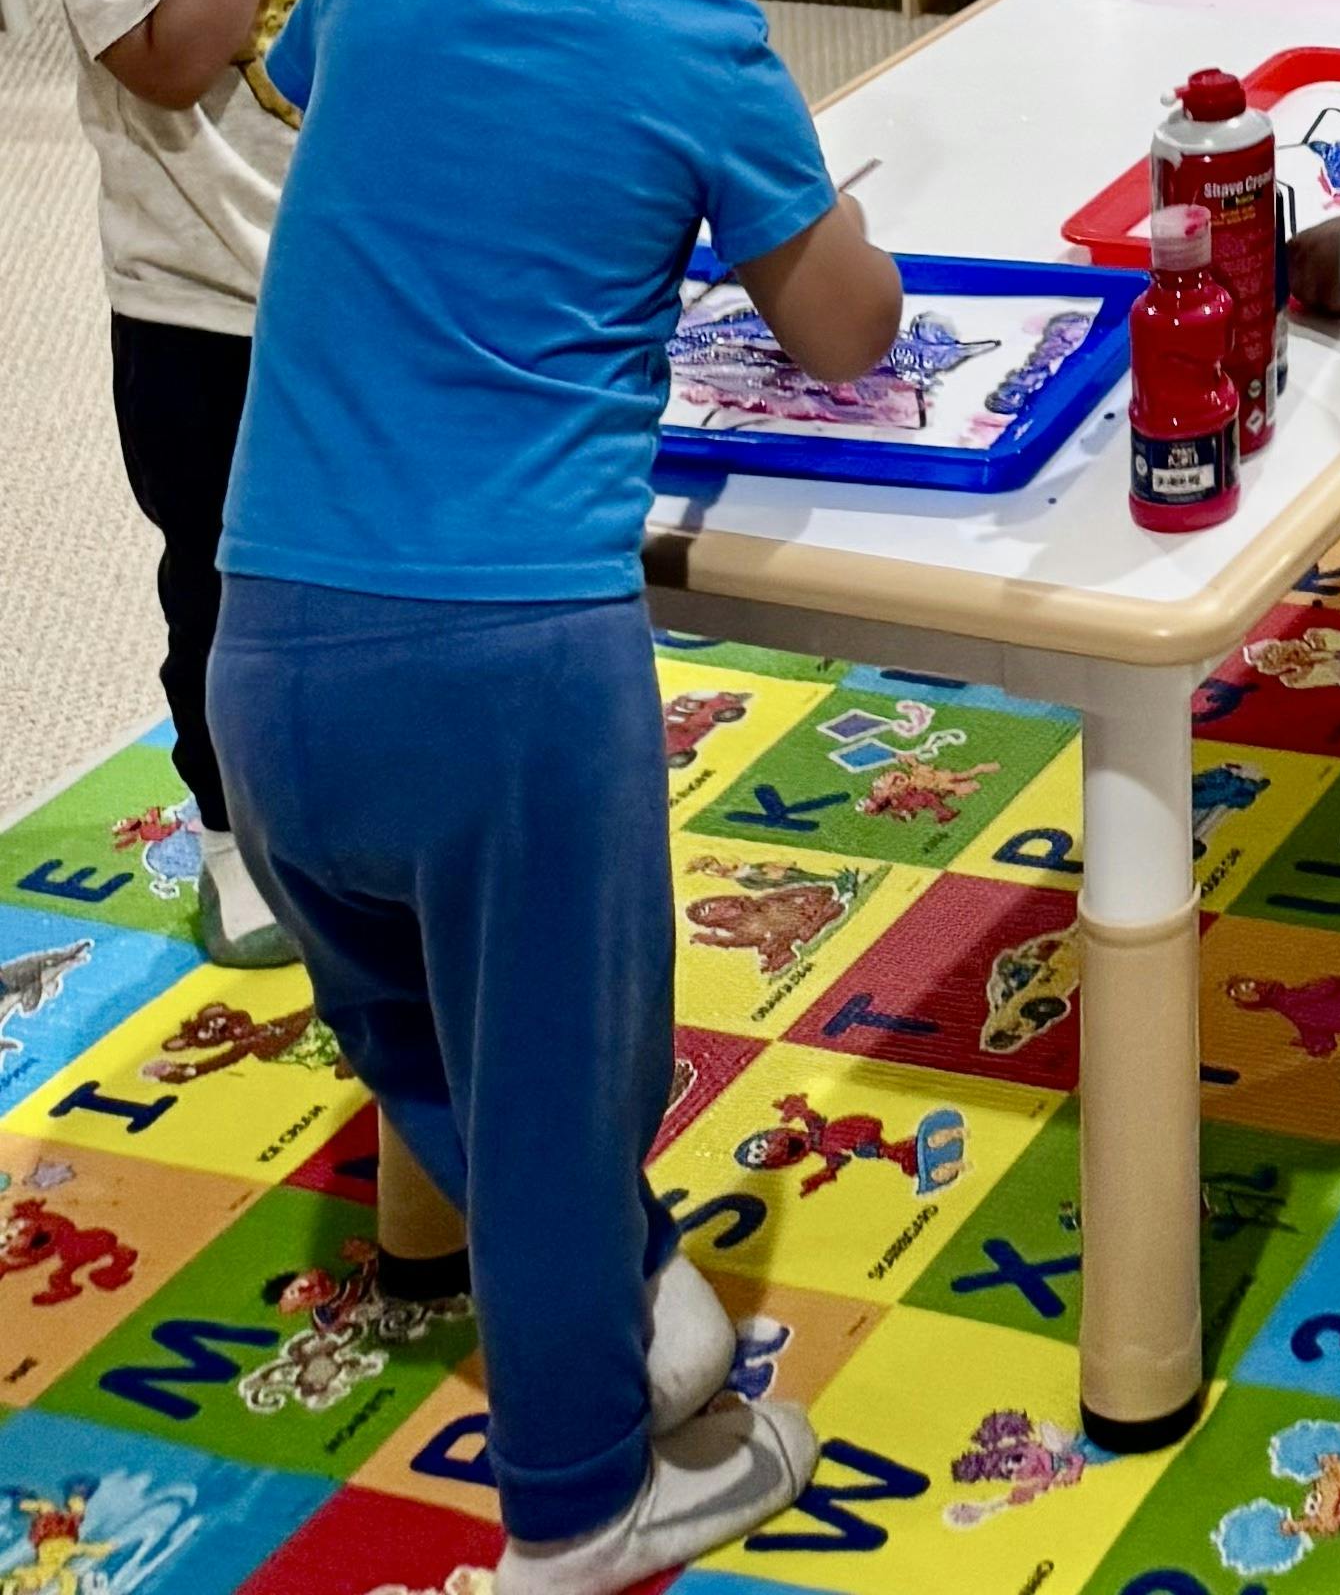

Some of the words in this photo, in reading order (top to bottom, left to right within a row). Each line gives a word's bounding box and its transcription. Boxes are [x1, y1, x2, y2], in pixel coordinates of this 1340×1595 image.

[1203, 180, 1244, 199] Shave
[724, 783, 851, 831] K
[992, 827, 1084, 874] P
[17, 859, 134, 903] E
[822, 992, 943, 1037] T
[49, 1080, 178, 1135] I
[951, 1238, 1082, 1318] X
